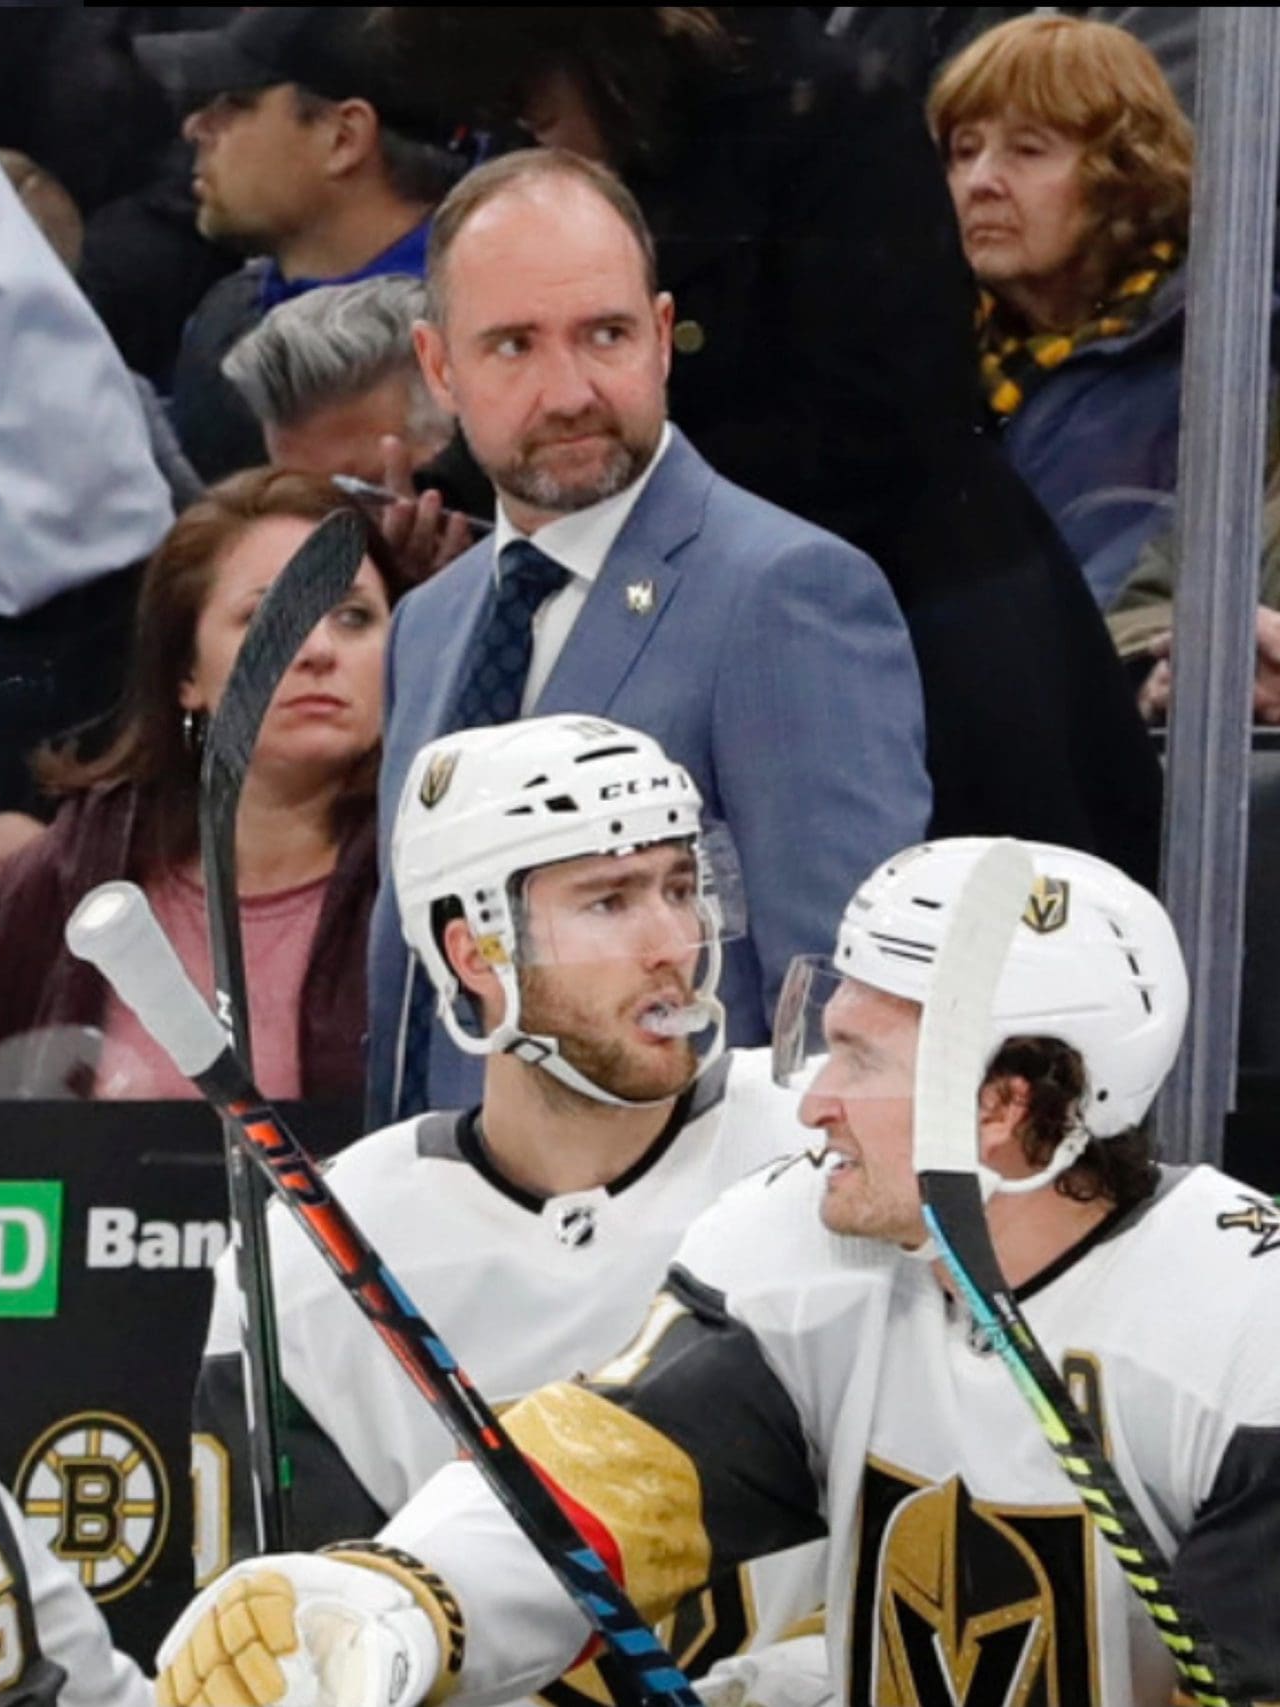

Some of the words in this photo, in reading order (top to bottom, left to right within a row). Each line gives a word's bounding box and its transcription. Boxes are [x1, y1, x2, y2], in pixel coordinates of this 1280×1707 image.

[598, 776, 670, 801] CCM
[86, 1206, 227, 1269] Ban
[51, 1456, 125, 1562] B
